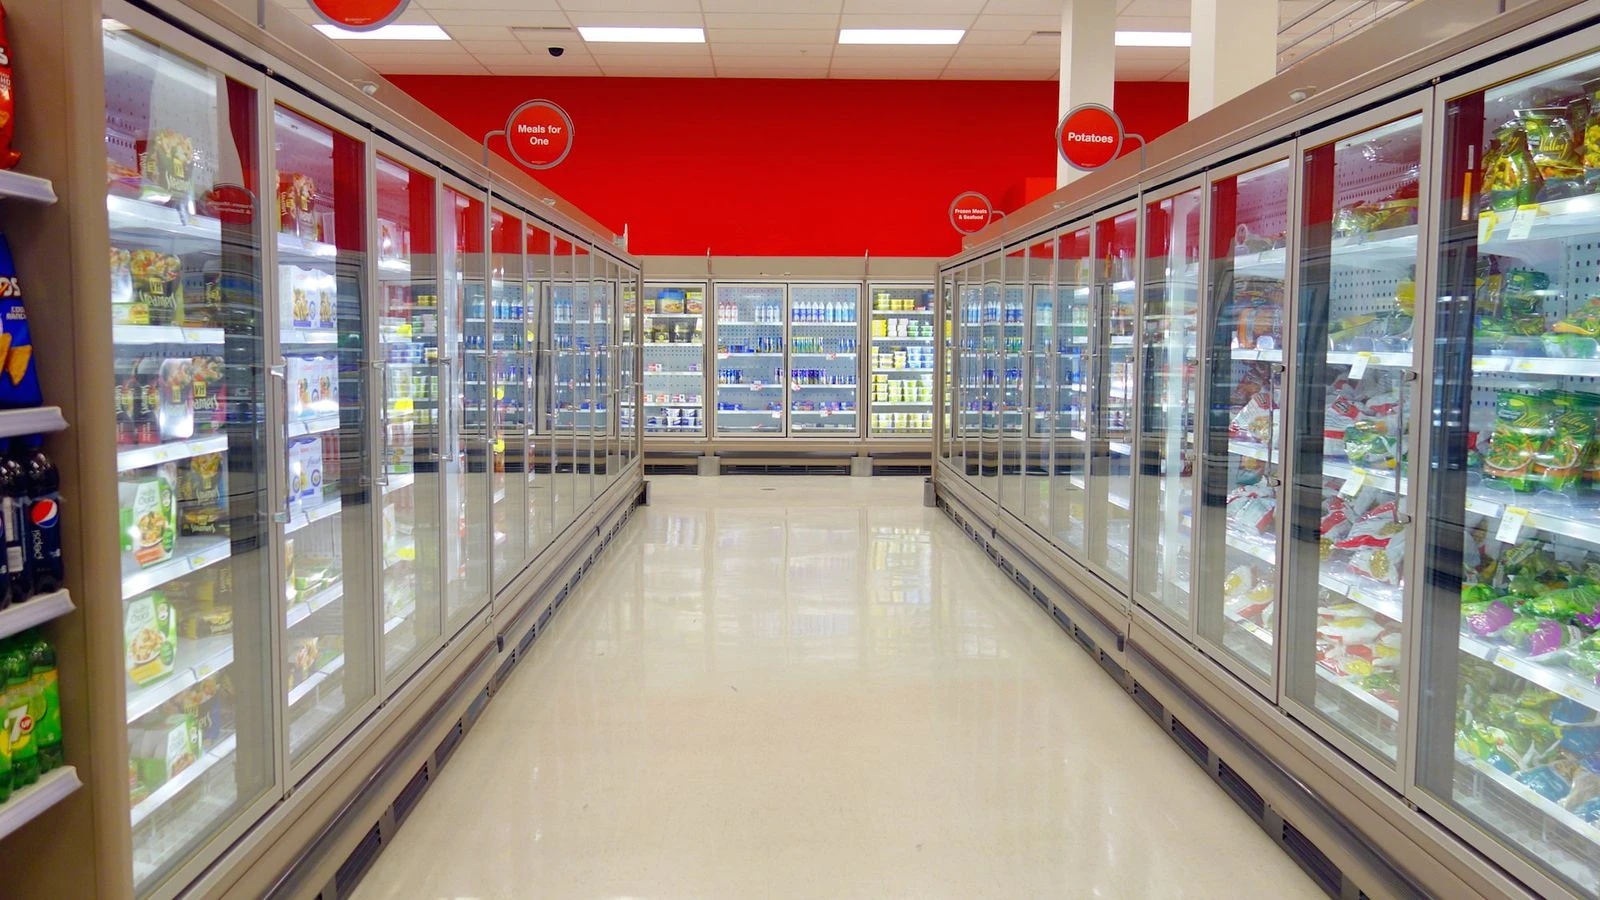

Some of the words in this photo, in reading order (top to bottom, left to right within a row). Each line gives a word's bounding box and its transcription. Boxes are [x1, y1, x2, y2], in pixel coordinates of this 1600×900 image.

[518, 124, 546, 133] Meals
[548, 125, 562, 134] for
[530, 136, 549, 145] One
[1068, 132, 1113, 143] Potatoes
[1538, 132, 1569, 158] Valley
[150, 281, 163, 291] VH
[194, 385, 207, 395] VH
